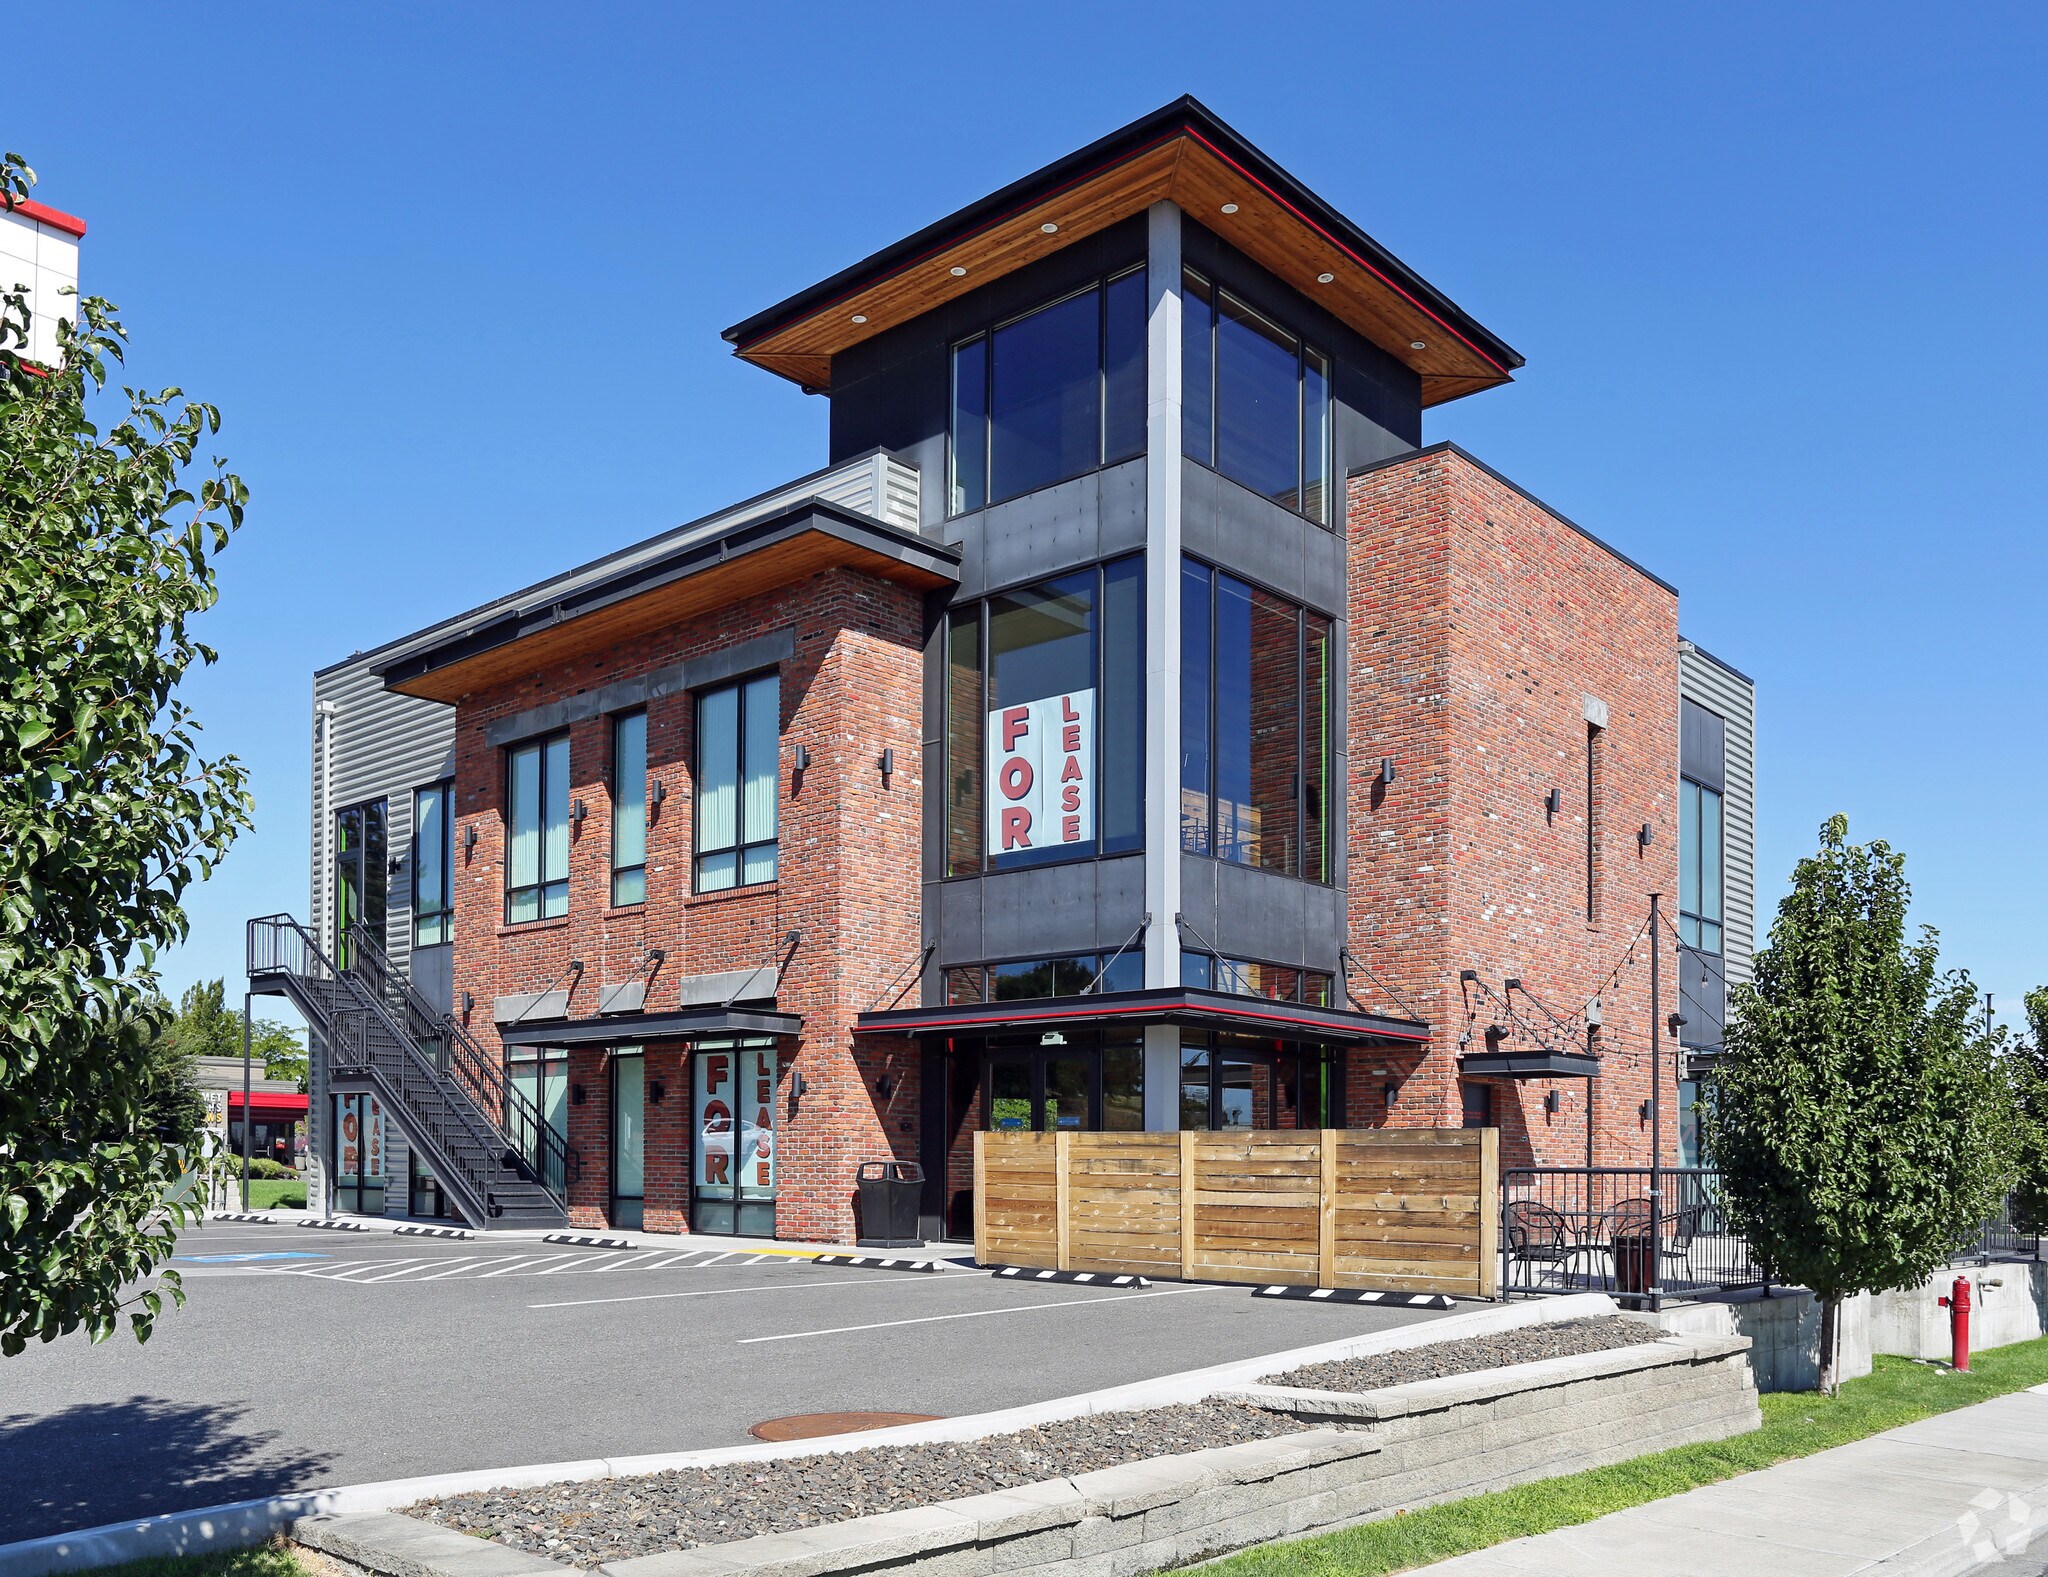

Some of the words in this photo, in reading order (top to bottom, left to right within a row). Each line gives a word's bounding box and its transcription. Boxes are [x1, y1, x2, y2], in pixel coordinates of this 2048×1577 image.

[1000, 706, 1034, 850] FOR
[1061, 696, 1083, 842] LEASE
[371, 1098, 380, 1175] EASE
[704, 1055, 731, 1184] FOR
[756, 1052, 773, 1185] LEASE
